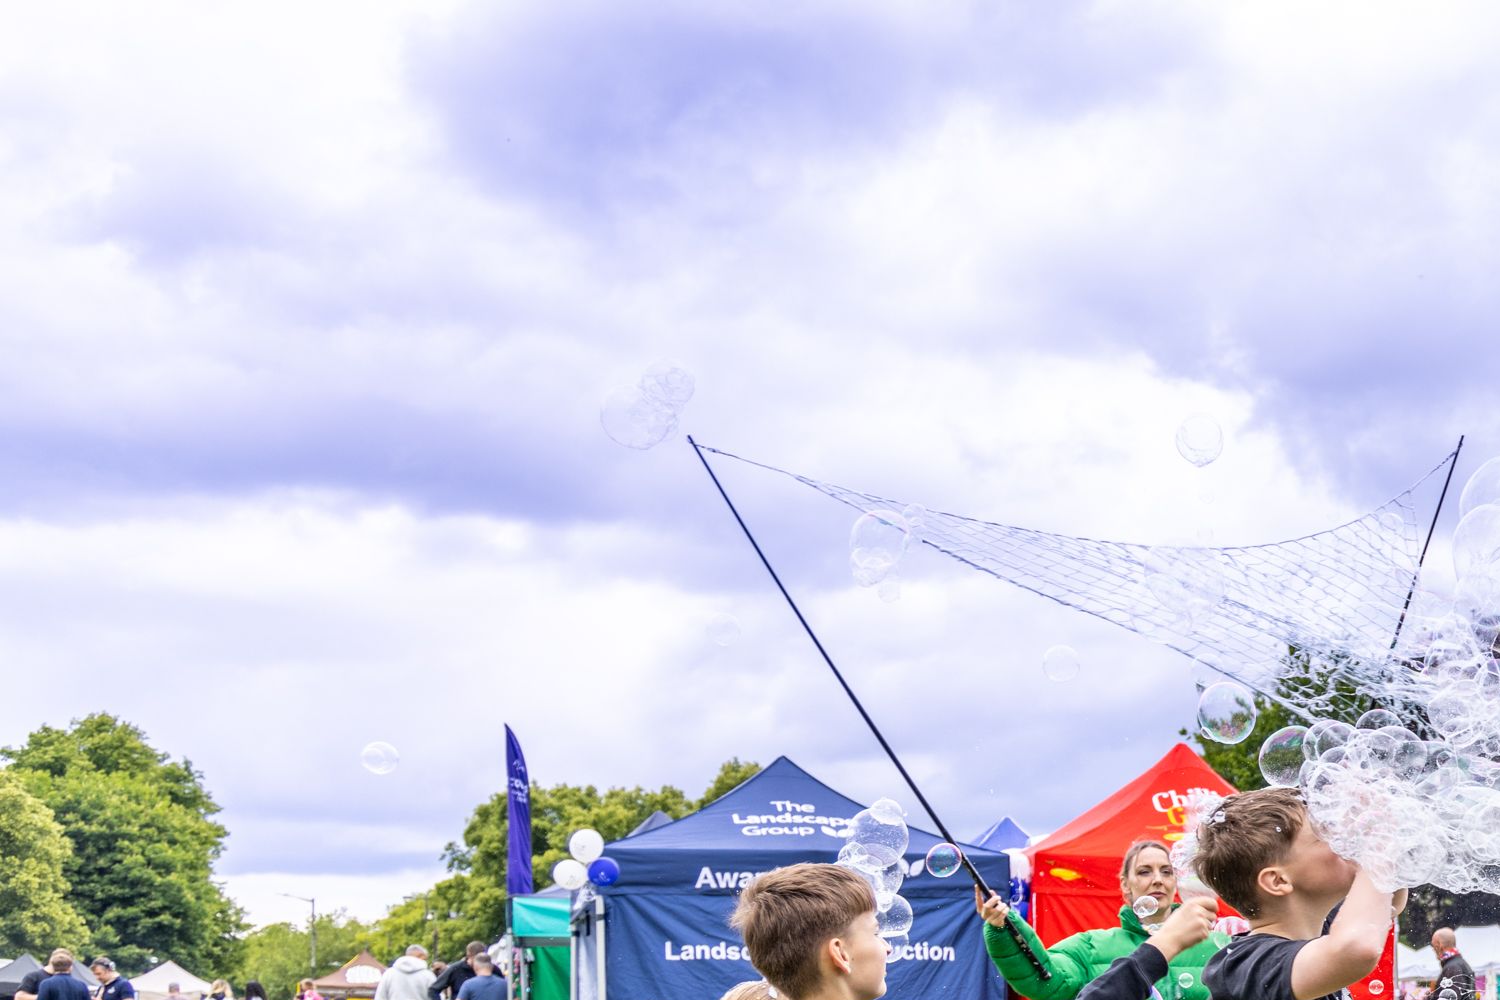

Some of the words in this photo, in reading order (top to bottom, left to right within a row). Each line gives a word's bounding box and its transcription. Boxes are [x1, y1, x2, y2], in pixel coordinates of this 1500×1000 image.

[769, 801, 816, 813] The
[741, 826, 816, 836] Group
[695, 866, 768, 888] Awa
